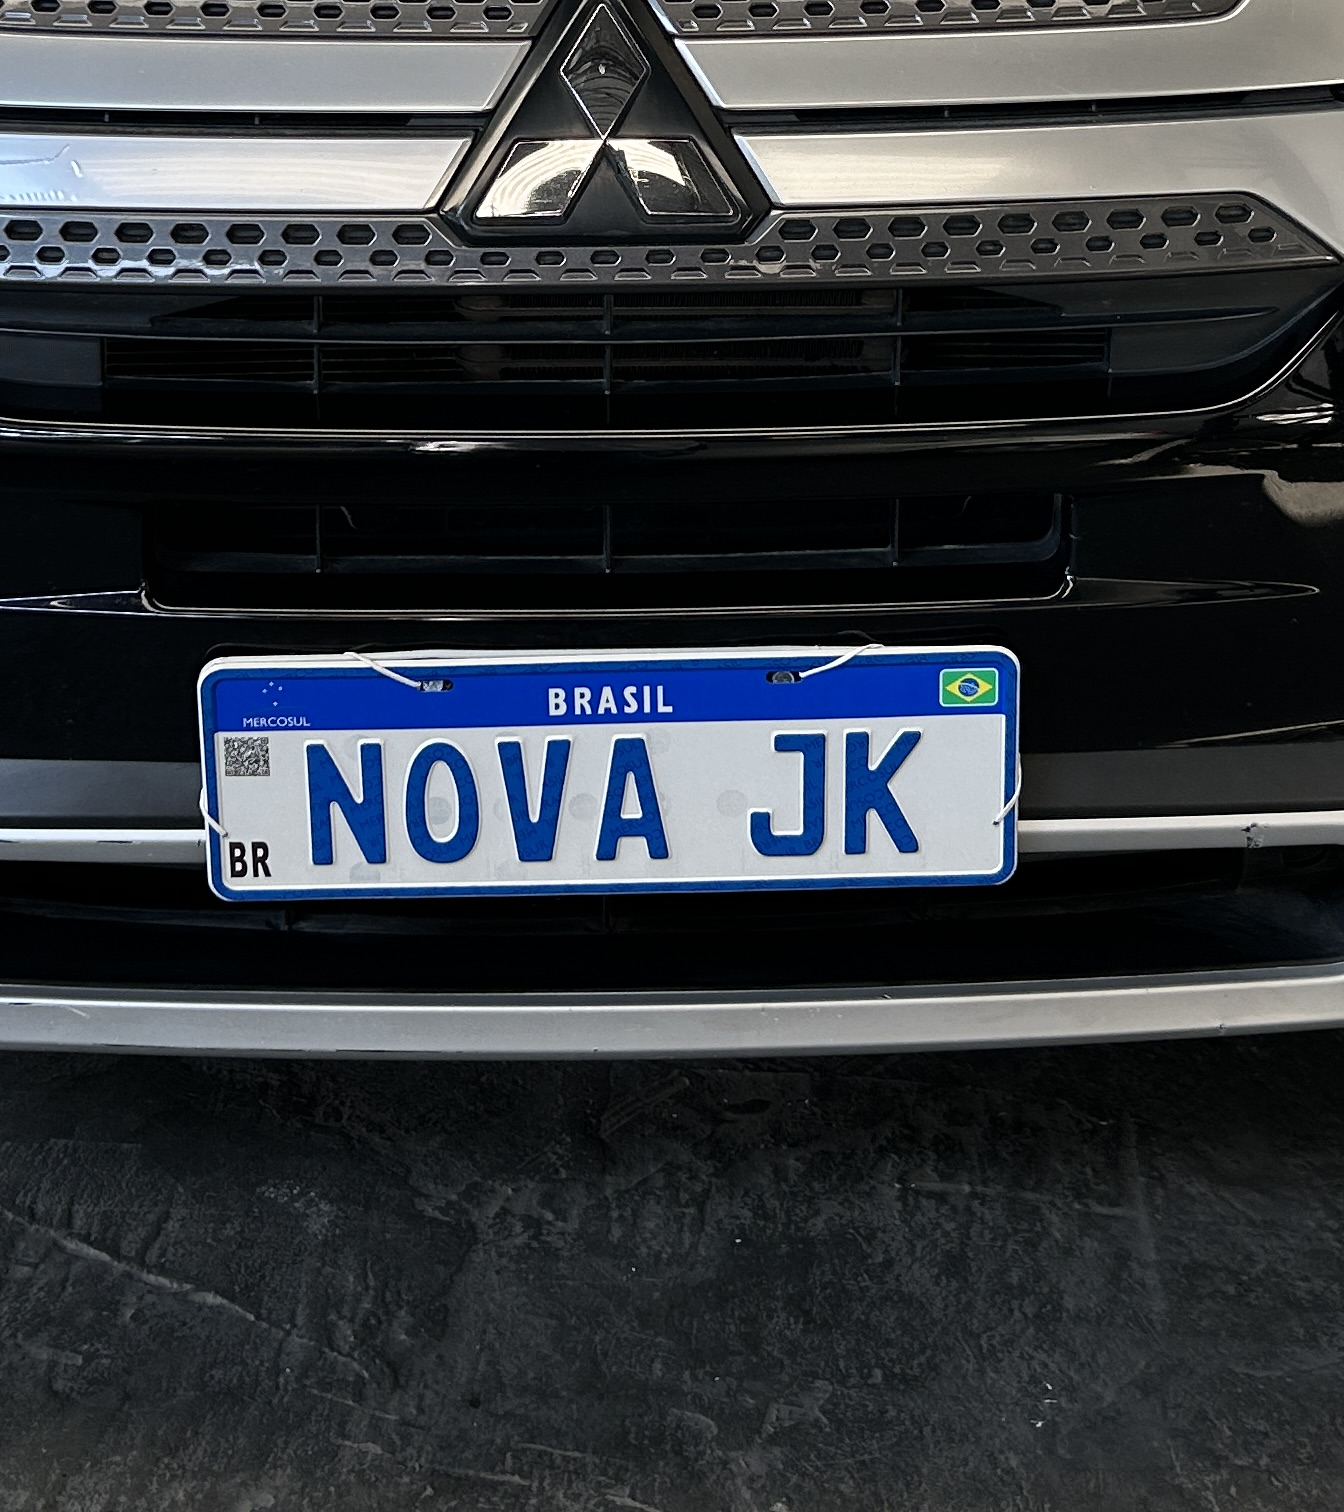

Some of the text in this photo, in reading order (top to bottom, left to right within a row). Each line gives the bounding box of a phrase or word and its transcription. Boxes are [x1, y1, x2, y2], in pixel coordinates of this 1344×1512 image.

[548, 684, 674, 717] BRASIL
[242, 716, 312, 728] MERCOSUL
[306, 729, 923, 867] NOVA JK
[228, 840, 272, 879] BR
